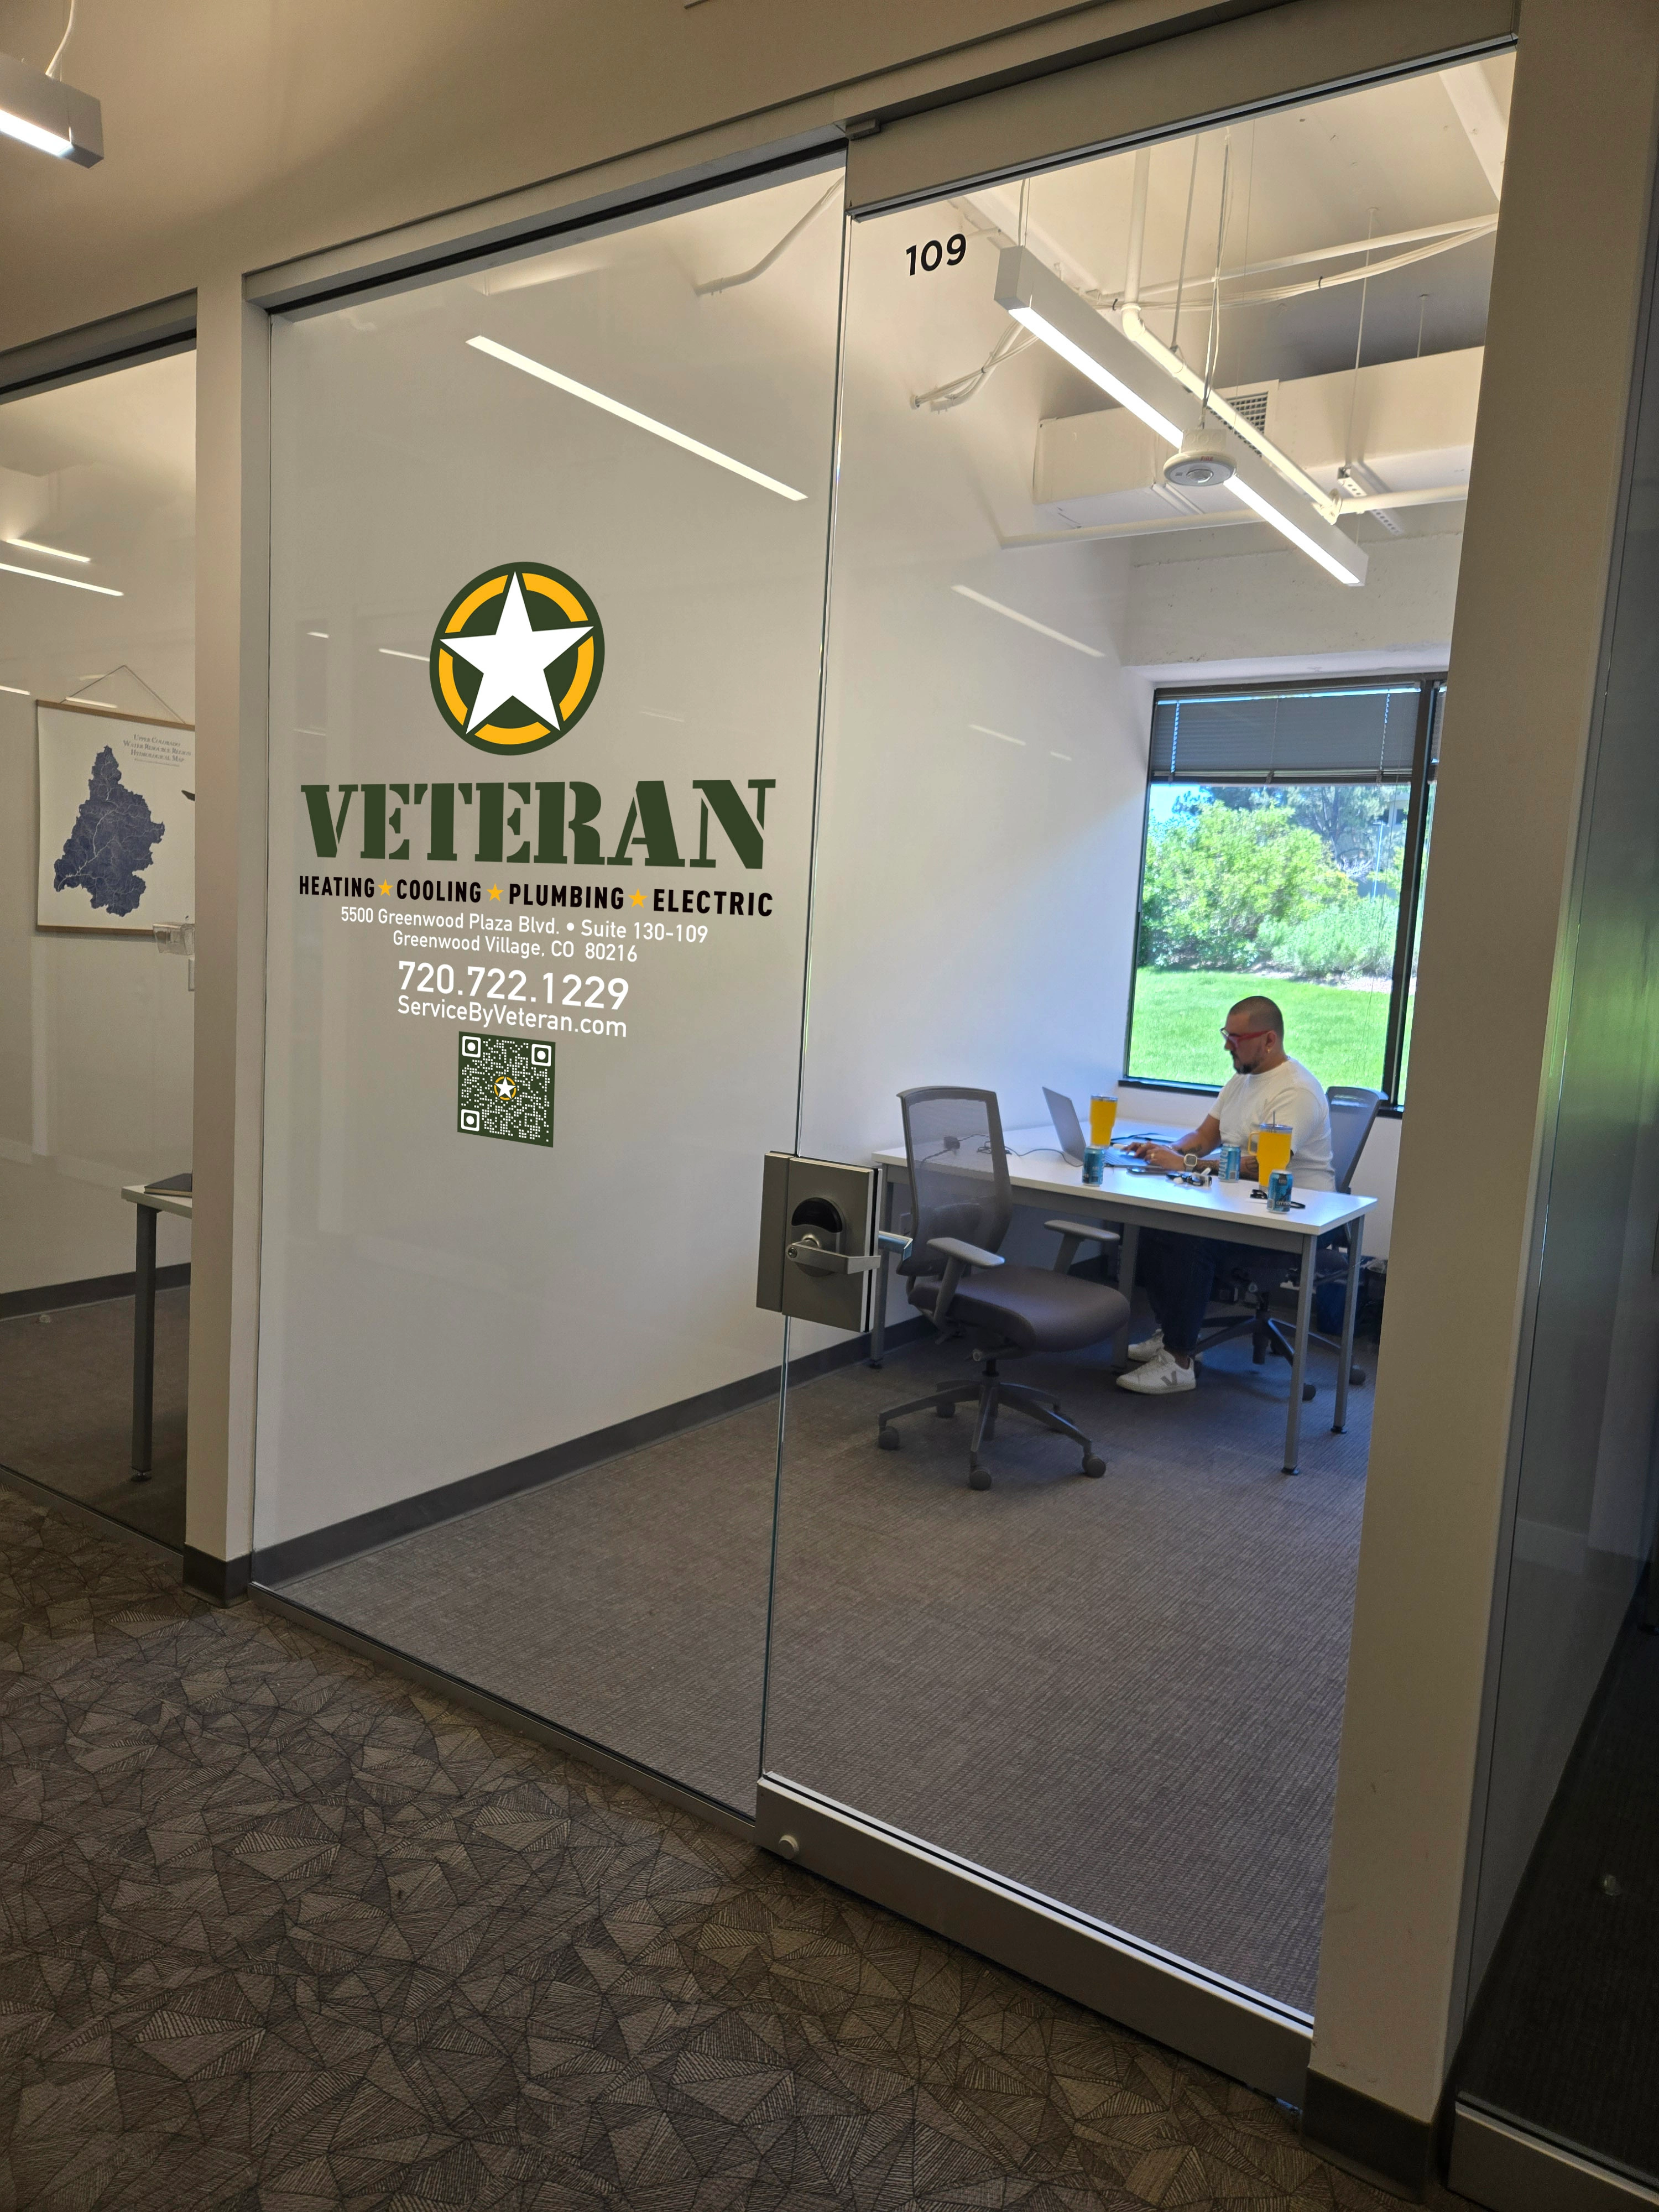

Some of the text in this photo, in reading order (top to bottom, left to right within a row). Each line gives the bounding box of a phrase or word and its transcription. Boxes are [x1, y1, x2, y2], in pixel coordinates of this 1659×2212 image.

[906, 233, 966, 276] 109
[300, 779, 776, 869] VETERAN
[299, 875, 773, 917] HEATING COOLING PLUMBING ELECTRIC
[341, 906, 708, 943] 5500 Greenwood Plaza Blvd. Suite 130-109
[393, 930, 638, 962] Greenwood Village, CO 80216
[399, 961, 629, 1010] 720.722.1229
[398, 995, 627, 1037] ServiceByVeteran.com
